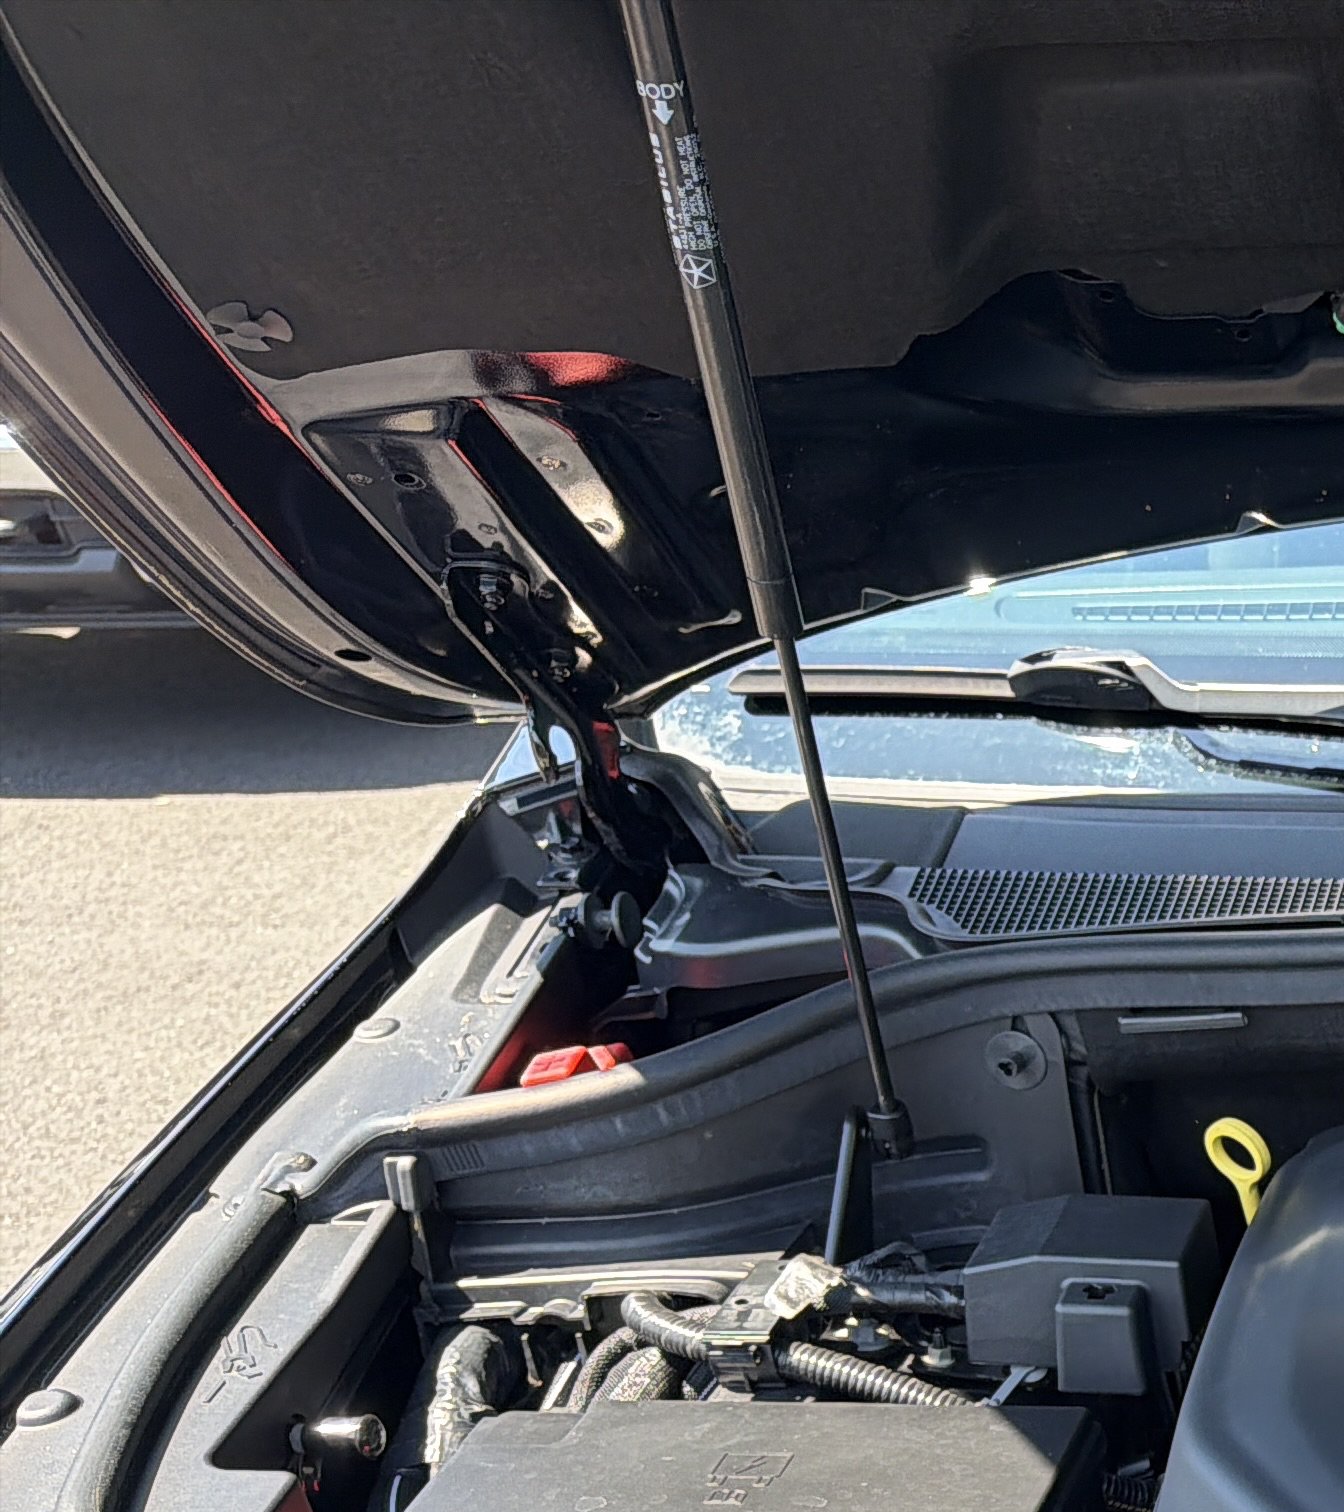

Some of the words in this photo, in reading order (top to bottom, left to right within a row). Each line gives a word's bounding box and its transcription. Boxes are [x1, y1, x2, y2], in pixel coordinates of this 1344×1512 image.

[636, 80, 684, 99] BODY
[675, 135, 686, 156] HEAT
[680, 159, 690, 174] NOT
[648, 130, 682, 250] STABILUS
[684, 177, 693, 190] DO
[676, 183, 692, 227] PRESSURE
[693, 220, 703, 235] NOT
[687, 231, 697, 250] HIGH
[697, 238, 706, 250] DO
